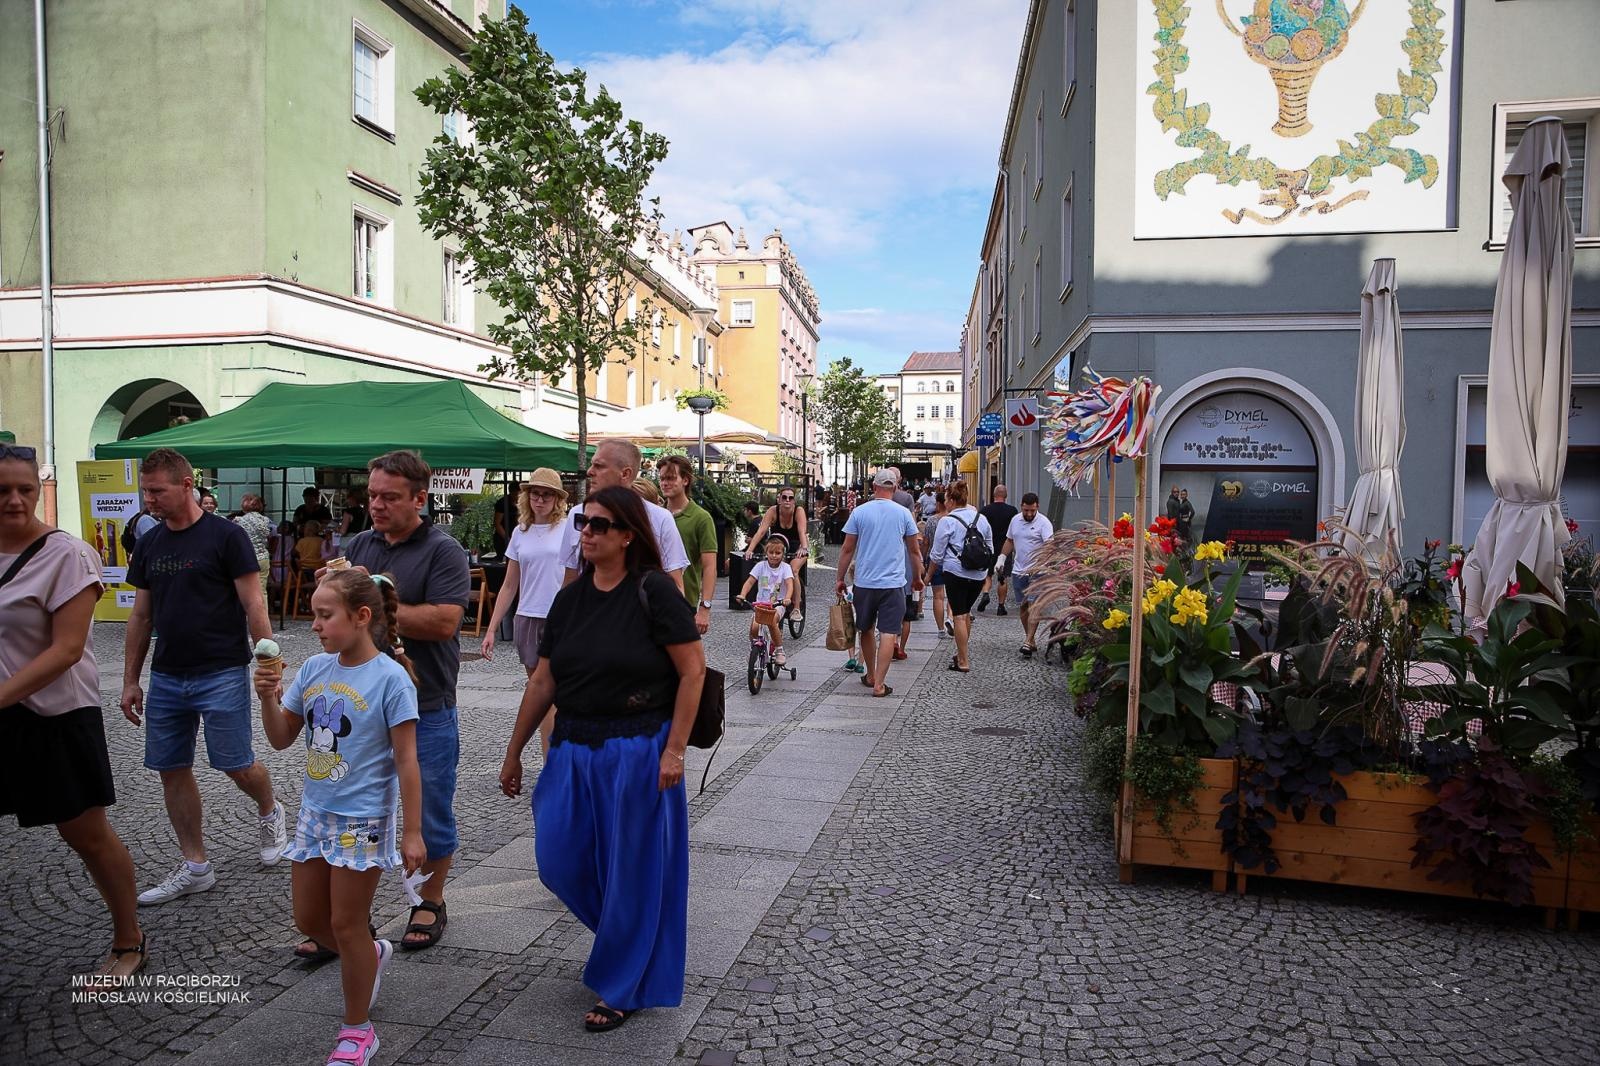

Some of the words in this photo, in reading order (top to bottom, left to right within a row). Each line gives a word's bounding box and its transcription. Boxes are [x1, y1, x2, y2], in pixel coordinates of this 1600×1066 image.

[1224, 409, 1268, 421] DYMEL
[432, 479, 473, 489] RYBNIKA
[1272, 482, 1310, 493] DYMEL
[96, 498, 134, 506] ZARAŻAMY
[1238, 544, 1257, 552] 723
